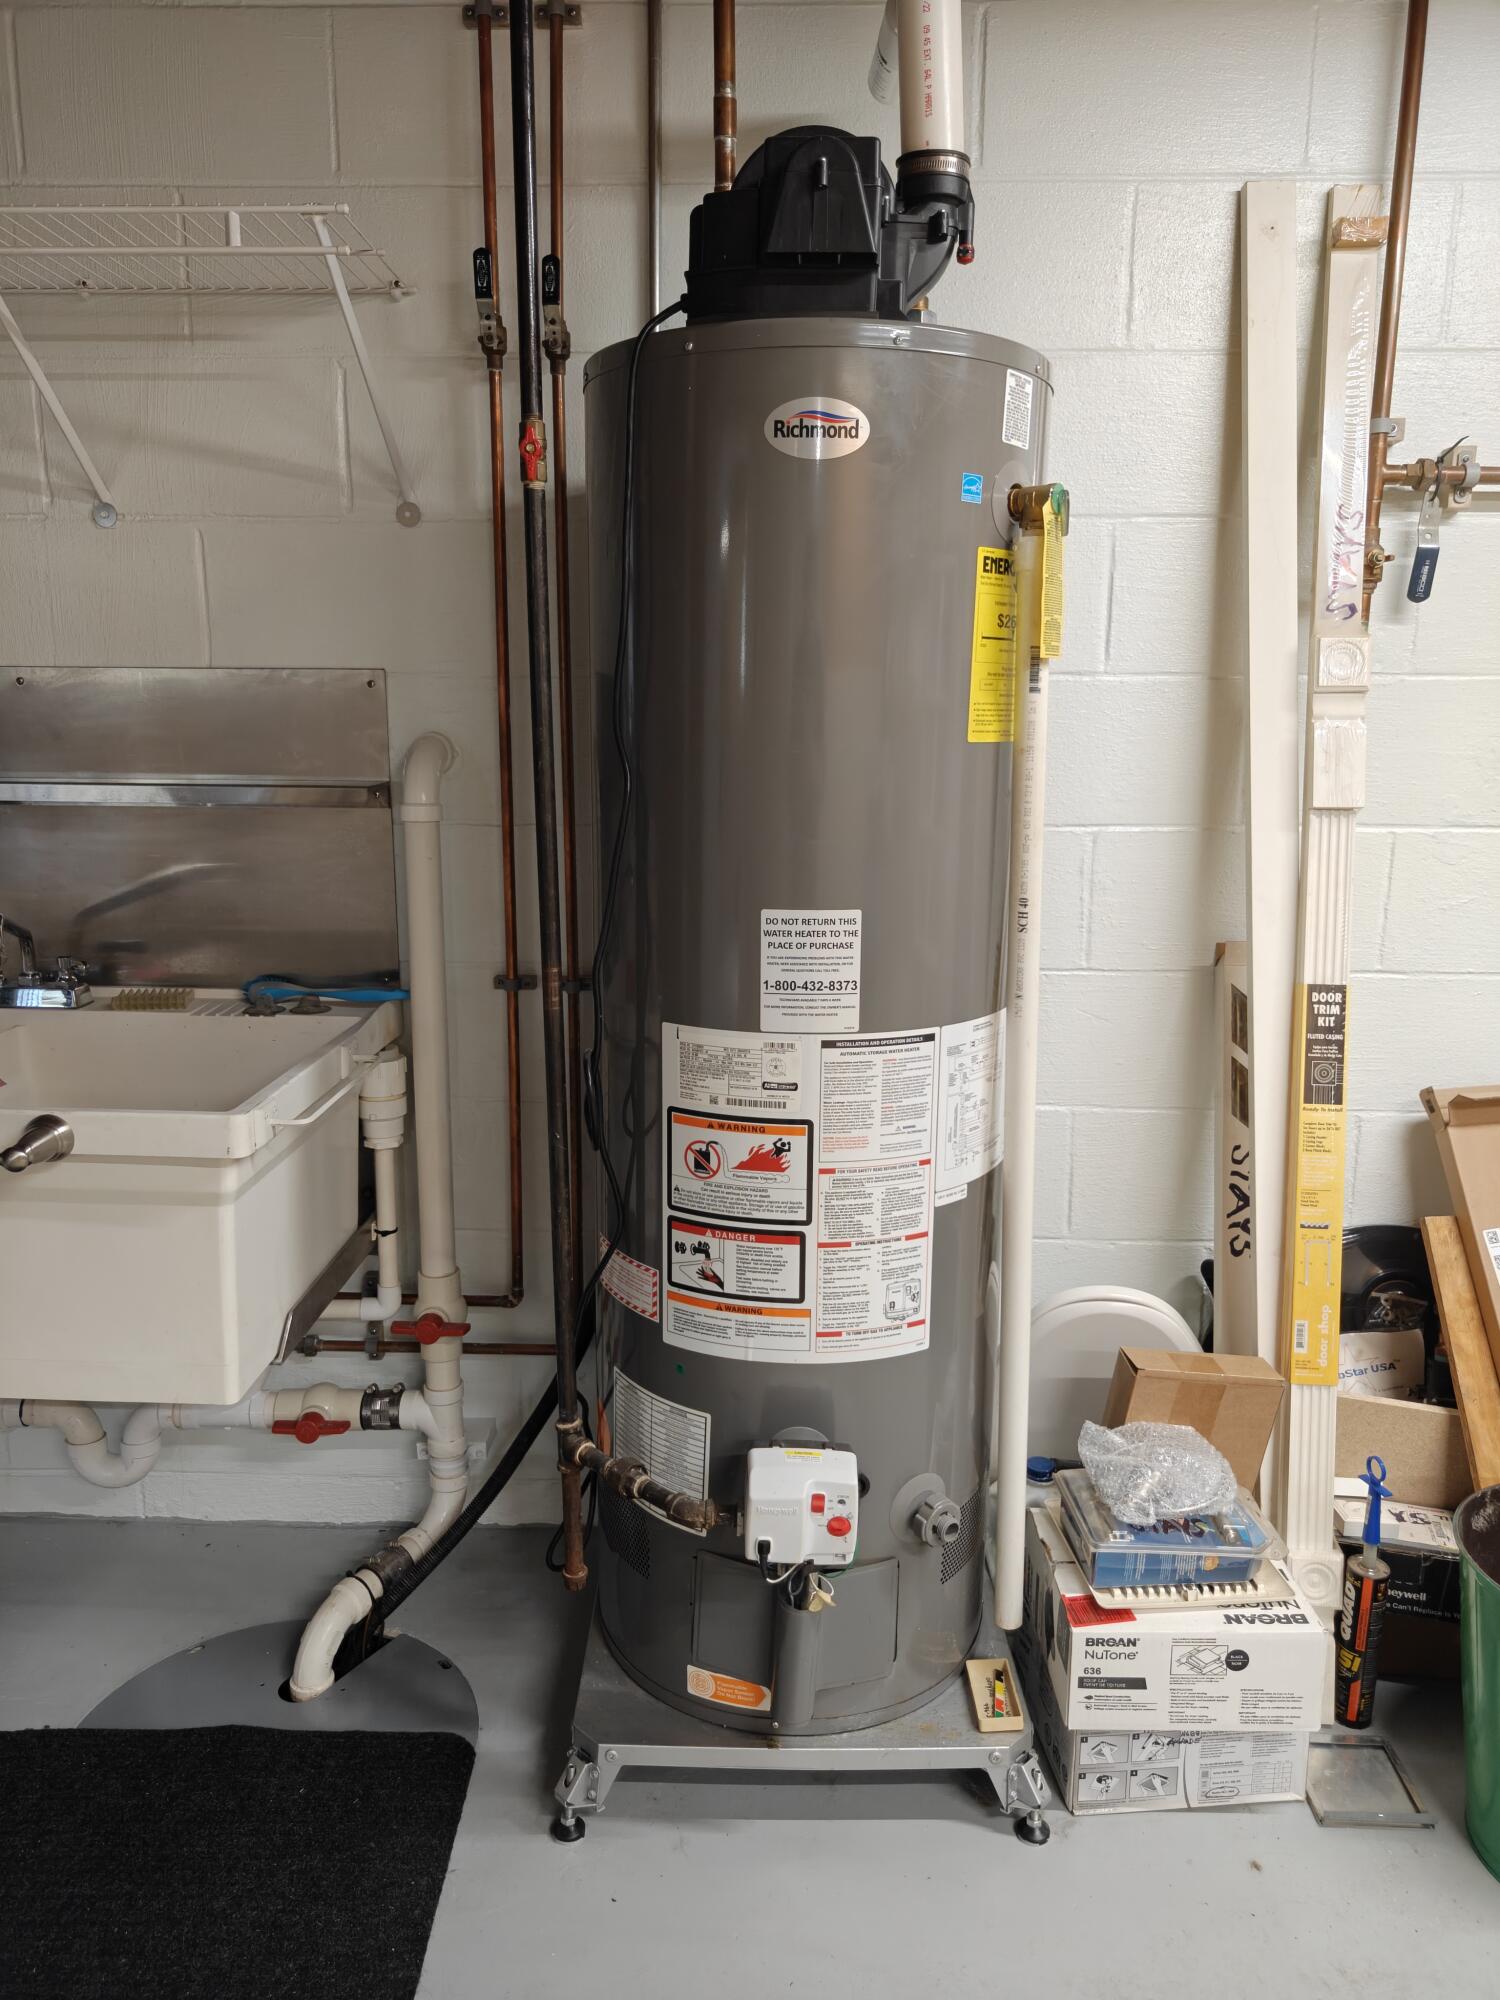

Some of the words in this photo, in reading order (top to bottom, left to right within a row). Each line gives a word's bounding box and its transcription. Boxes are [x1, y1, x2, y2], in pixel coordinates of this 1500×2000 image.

[774, 418, 860, 439] Richmond
[1018, 898, 1029, 909] 40
[1017, 912, 1028, 934] SCH
[763, 980, 858, 991] 1-800-432-8373
[1312, 992, 1342, 1003] DOOR
[1313, 1004, 1340, 1015] TRIM
[1318, 1016, 1335, 1027] KIT
[718, 1123, 766, 1133] WARNING
[715, 1230, 756, 1242] DANGER
[724, 1305, 763, 1315] WARNING
[1318, 1304, 1332, 1334] shop
[1317, 1338, 1328, 1367] door
[1371, 1362, 1397, 1373] USA
[756, 1504, 798, 1515] Honeywell
[1387, 1589, 1427, 1600] neywell
[1340, 1581, 1355, 1640] QUAD
[1392, 1602, 1411, 1611] Can't
[1085, 1650, 1136, 1660] NuTone
